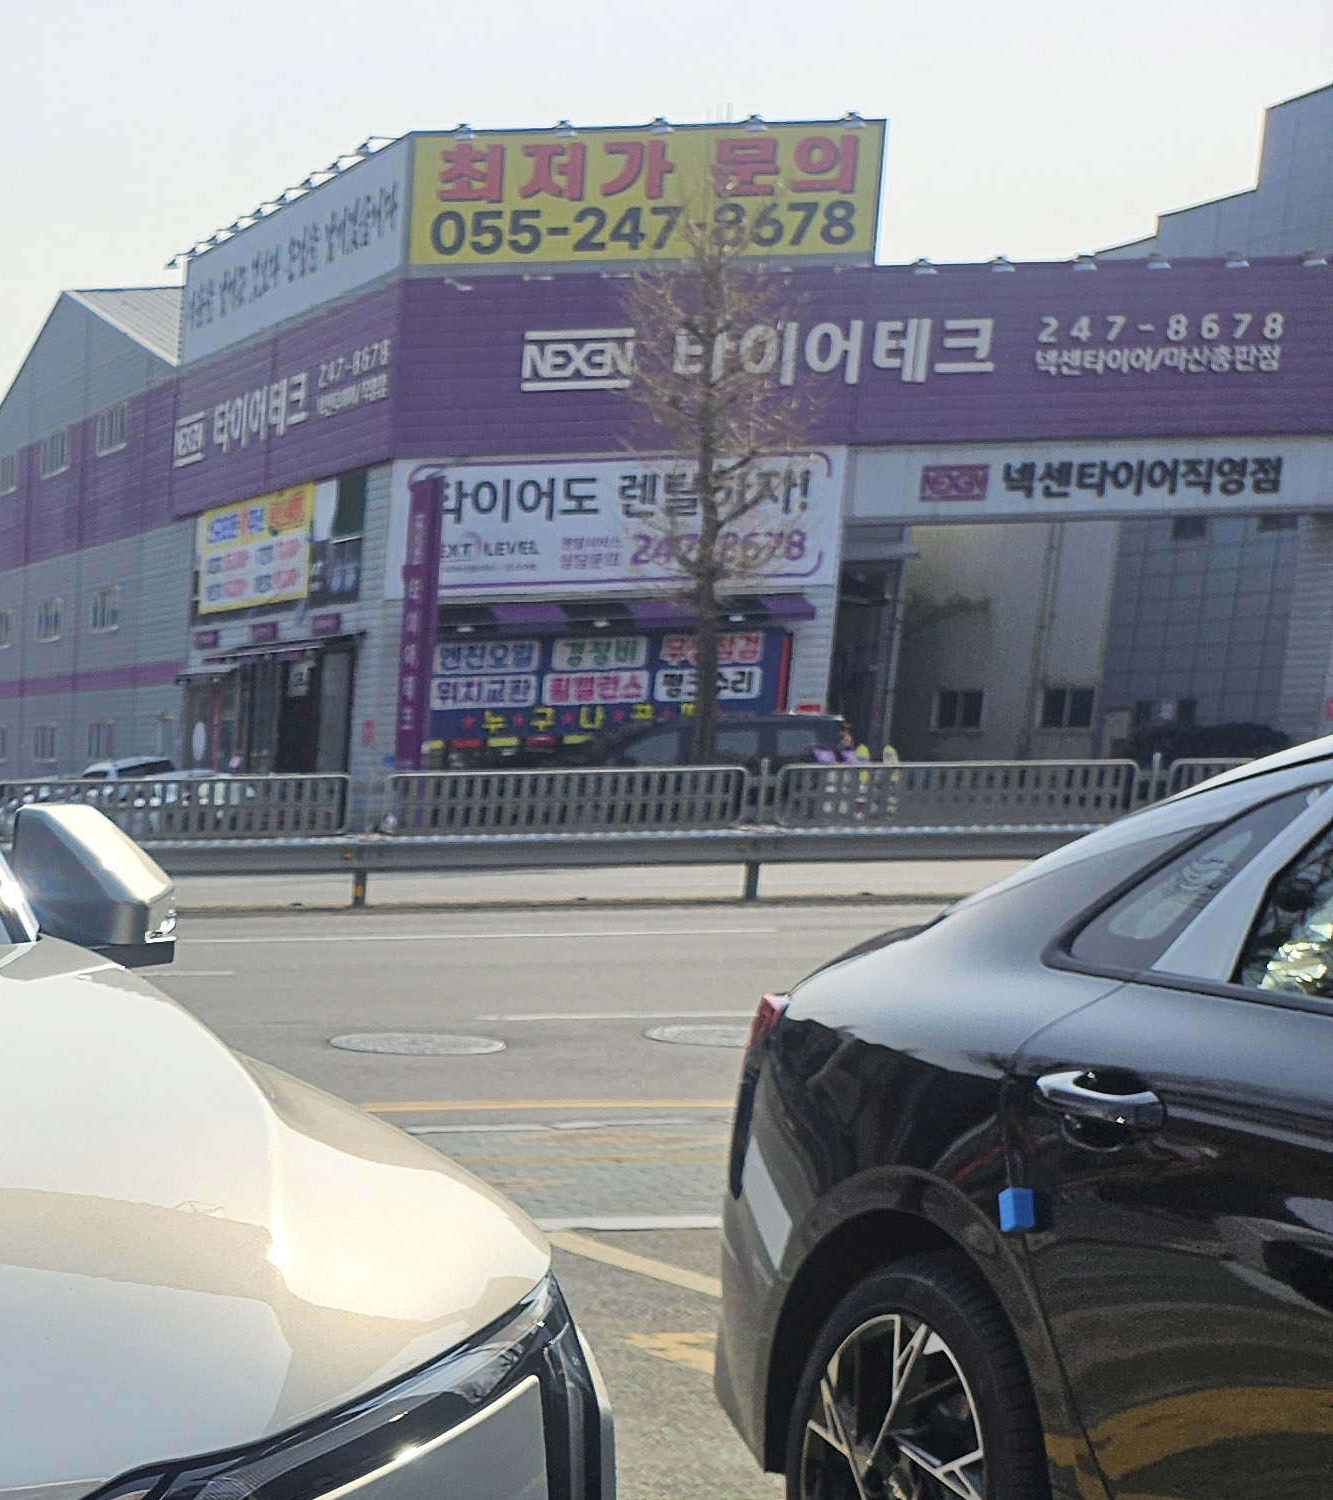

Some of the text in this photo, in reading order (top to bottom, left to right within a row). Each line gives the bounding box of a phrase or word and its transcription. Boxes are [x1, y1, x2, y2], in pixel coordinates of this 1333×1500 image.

[437, 135, 859, 203] 최저가 문의
[1037, 312, 1285, 343] 247-8678
[521, 327, 636, 392] NEXEN
[671, 316, 996, 386] 타이어테크
[213, 371, 309, 453] 타이어테크
[1003, 456, 1284, 500] 넥센타이어직영점
[630, 529, 808, 566] 2478678
[439, 643, 535, 671] 엔진오일
[564, 639, 638, 668] 경정비
